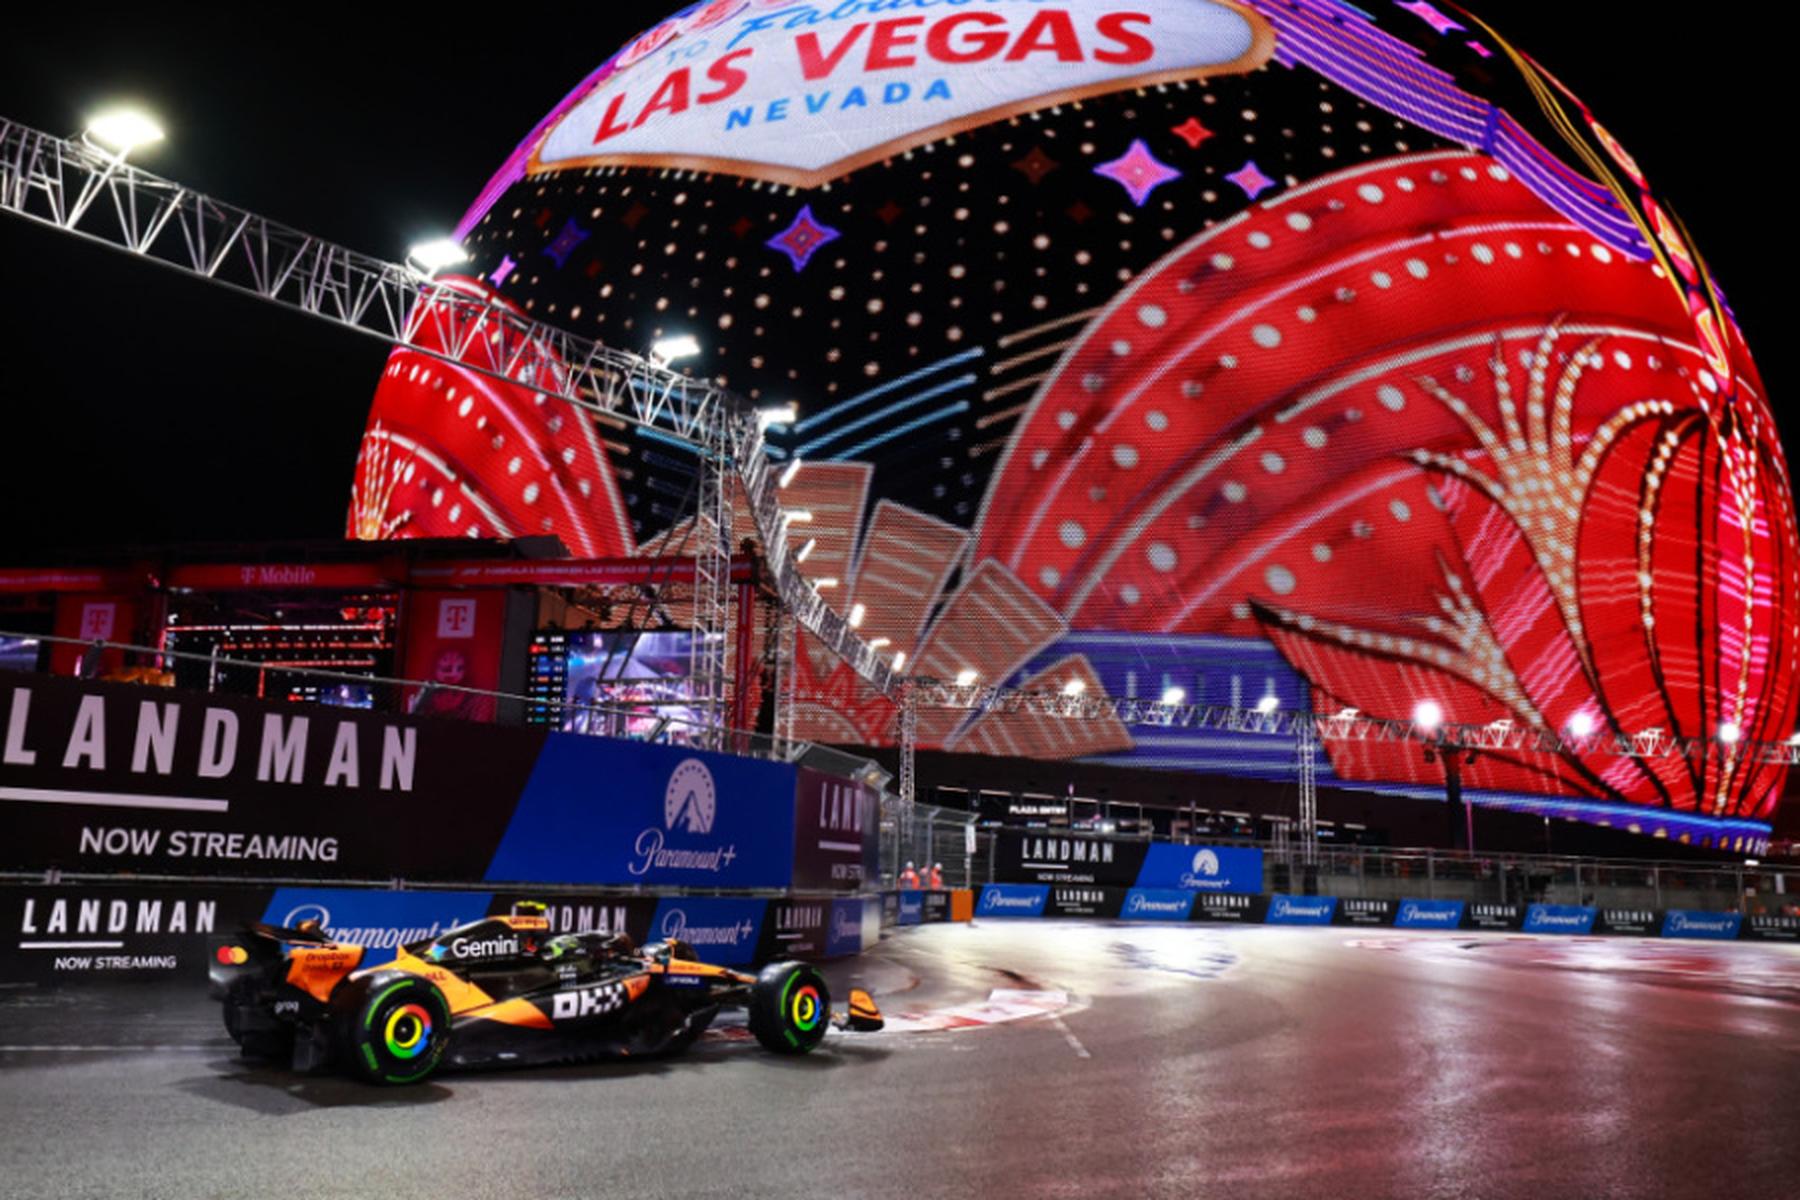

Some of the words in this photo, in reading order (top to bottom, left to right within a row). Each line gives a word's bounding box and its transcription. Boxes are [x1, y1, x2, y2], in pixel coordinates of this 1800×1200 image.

[592, 47, 753, 145] LAS
[795, 10, 1155, 80] VEGAS
[726, 79, 953, 130] NEVADA
[3, 688, 417, 791] LANDMAN
[79, 827, 160, 856] NOW
[167, 831, 339, 862] STREAMING
[628, 827, 736, 875] Paramount+
[1022, 838, 1113, 862] LANDMAN
[22, 899, 216, 933] LANDMAN
[512, 906, 627, 934] LNDMAN
[661, 908, 752, 944] Paramount+
[55, 957, 91, 970] NOW
[95, 957, 176, 970] STREAMING
[452, 935, 518, 958] Gemini
[552, 983, 625, 1019] OKX
